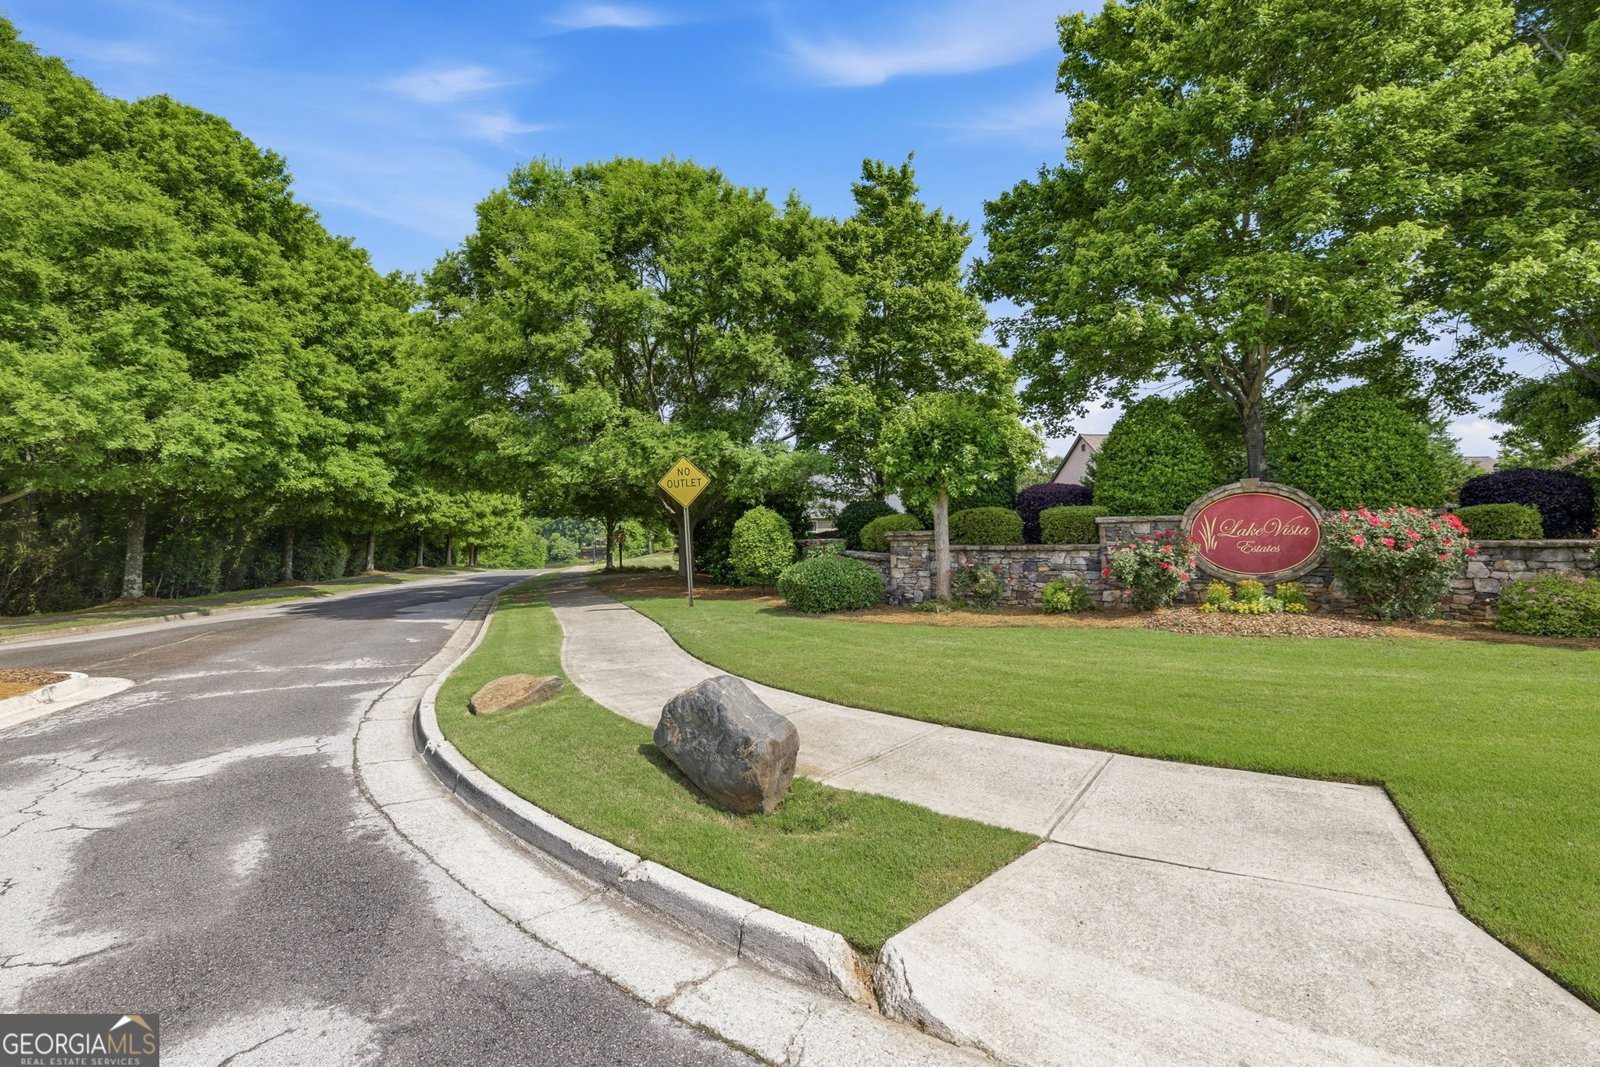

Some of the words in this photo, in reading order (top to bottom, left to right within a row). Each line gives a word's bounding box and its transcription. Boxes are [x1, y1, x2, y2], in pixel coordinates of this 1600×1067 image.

[677, 467, 690, 476] NO
[667, 478, 702, 488] OUTLET
[1217, 518, 1265, 538] Lake
[1263, 515, 1312, 537] Vista
[1236, 540, 1281, 554] Estates
